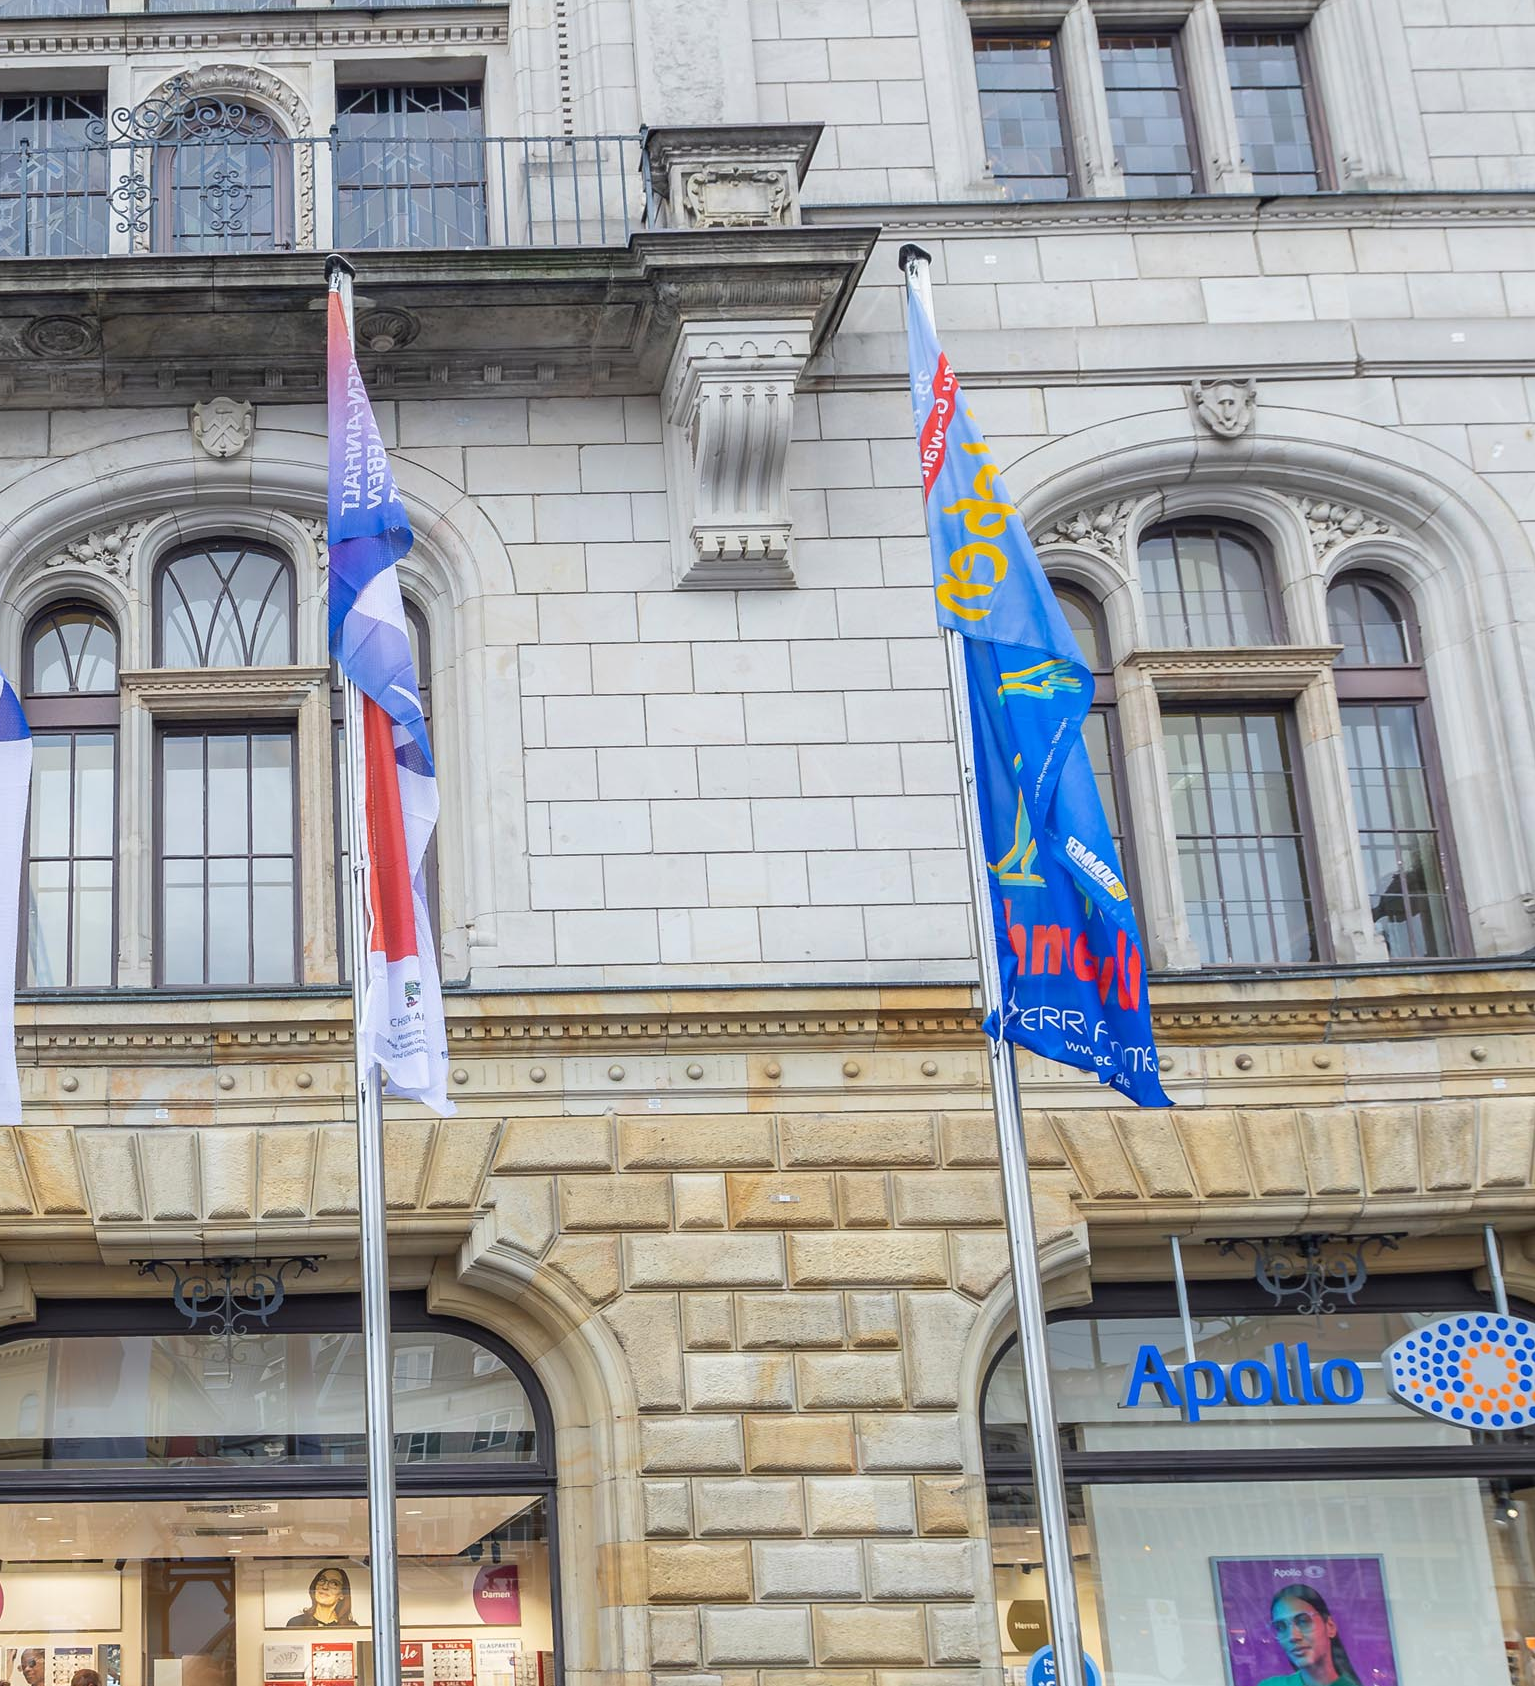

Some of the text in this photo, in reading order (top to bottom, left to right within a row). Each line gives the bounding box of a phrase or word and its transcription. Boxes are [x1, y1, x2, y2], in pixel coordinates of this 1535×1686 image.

[1122, 1342, 1364, 1423] Apollo
[1274, 1568, 1302, 1578] Apollo
[482, 1590, 510, 1599] Damen
[1014, 1621, 1040, 1630] Herren
